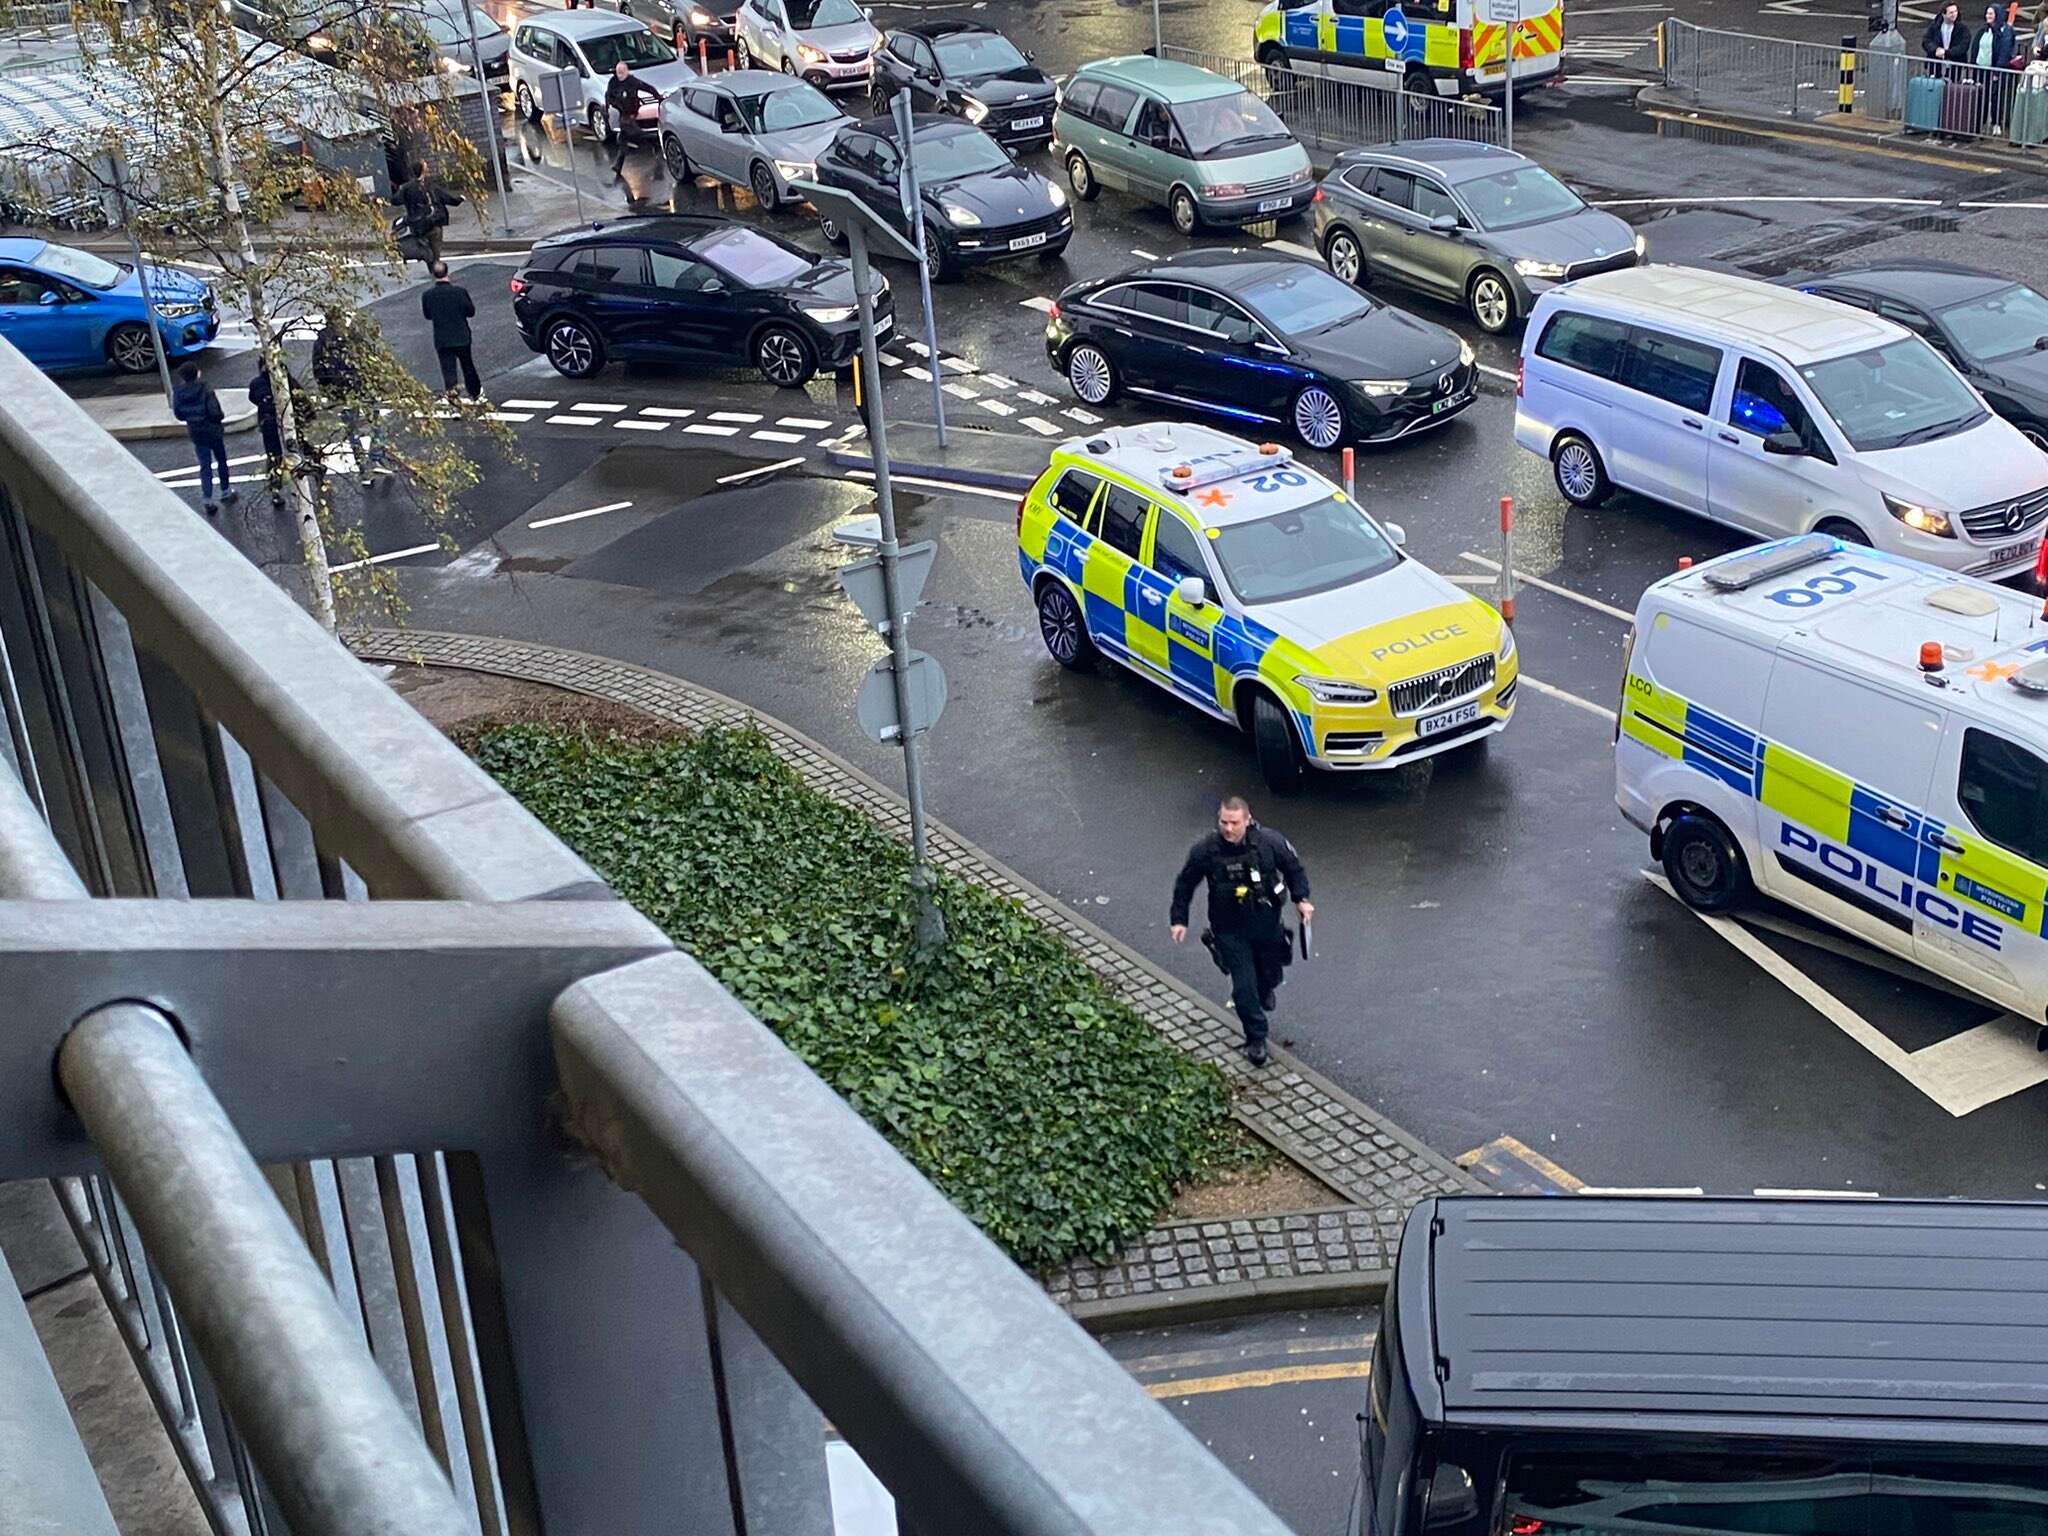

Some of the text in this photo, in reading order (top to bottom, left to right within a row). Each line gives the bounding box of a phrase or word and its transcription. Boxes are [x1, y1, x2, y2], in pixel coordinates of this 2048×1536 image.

[1764, 566, 1889, 607] LCQ
[1371, 623, 1468, 662] POLICE
[1630, 674, 1652, 696] LCQ
[1425, 705, 1477, 732] BX24 FSG
[1781, 821, 2003, 952] POLICE
[1980, 894, 2012, 913] POLICE
